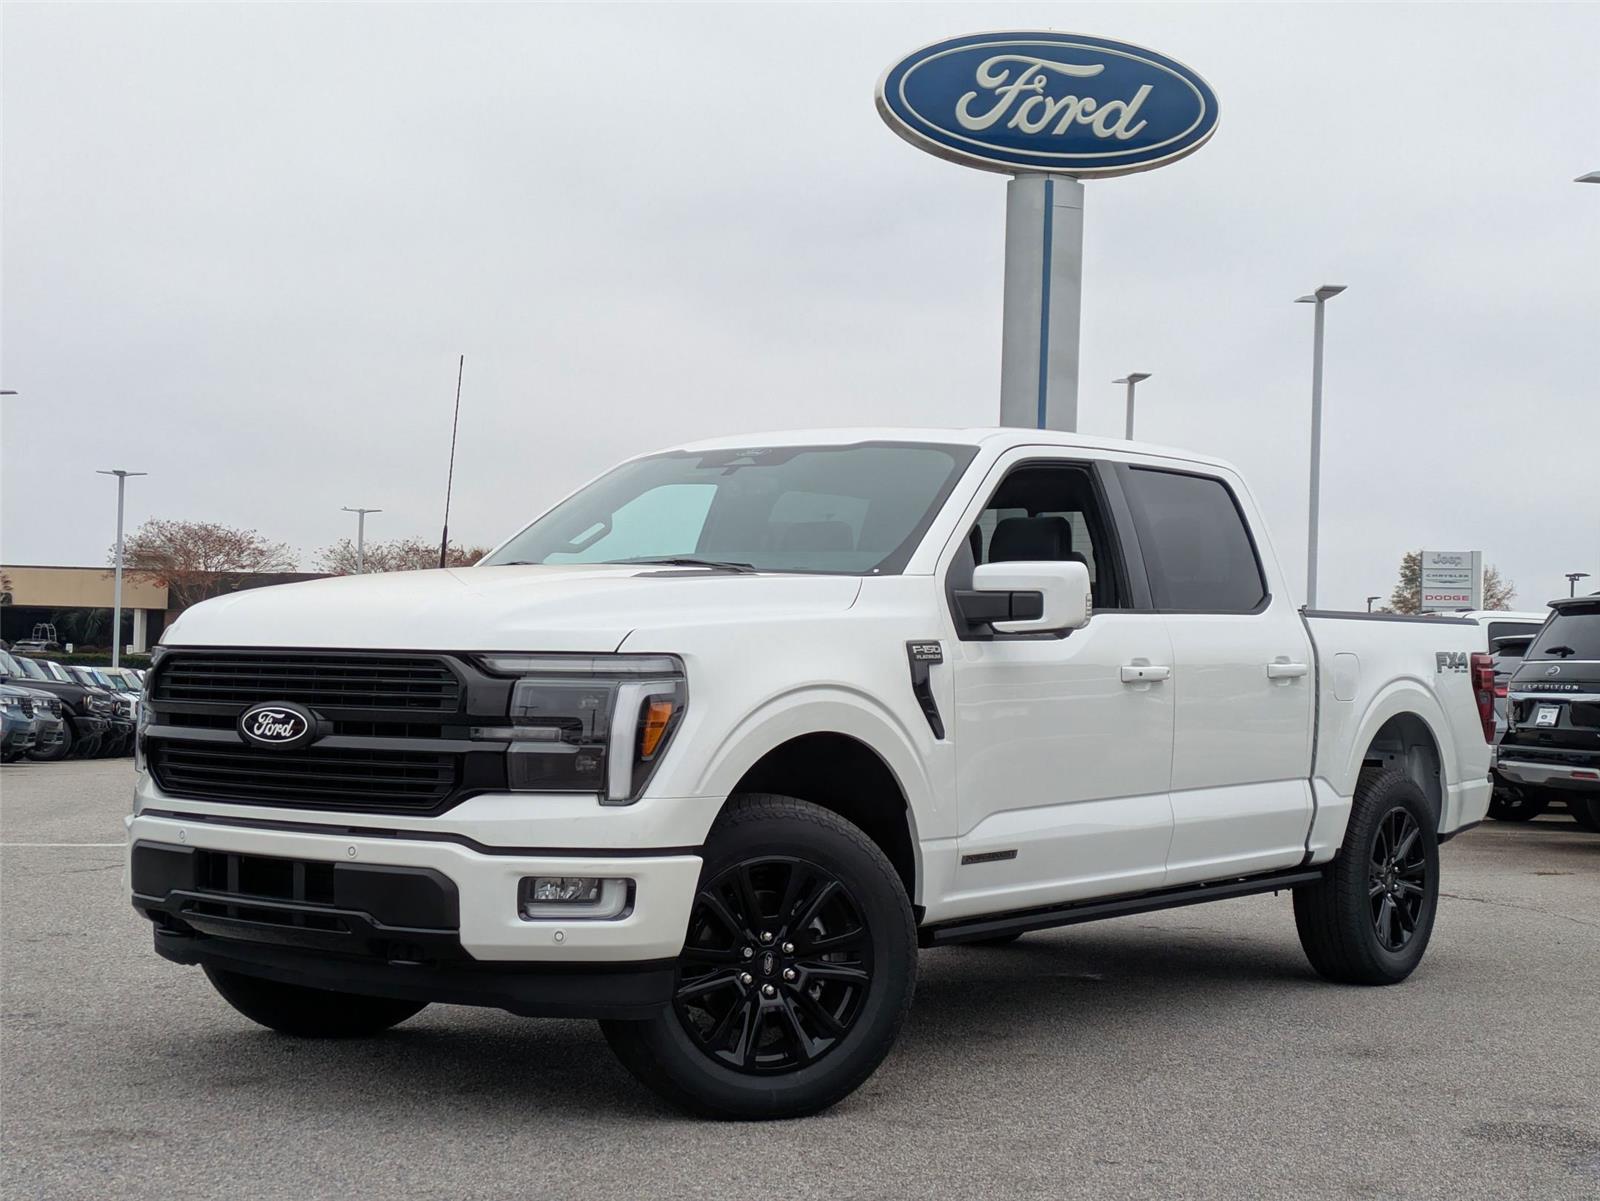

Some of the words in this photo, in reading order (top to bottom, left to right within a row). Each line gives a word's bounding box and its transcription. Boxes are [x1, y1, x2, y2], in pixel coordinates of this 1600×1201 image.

[955, 54, 1154, 140] Ford
[1432, 553, 1462, 567] Jeep
[912, 645, 941, 654] F-150
[1435, 651, 1468, 673] FX4
[253, 711, 295, 737] Ford
